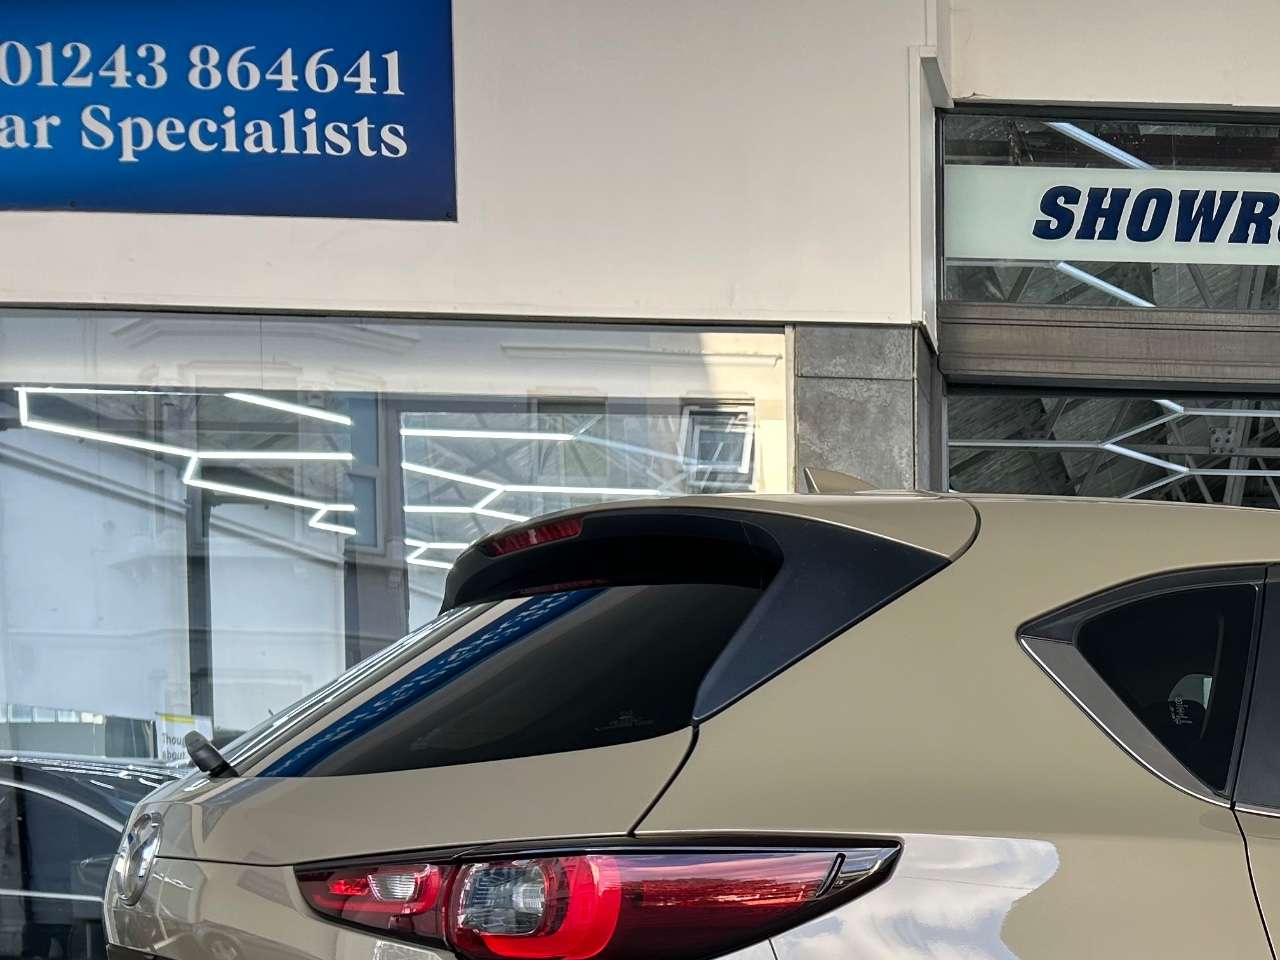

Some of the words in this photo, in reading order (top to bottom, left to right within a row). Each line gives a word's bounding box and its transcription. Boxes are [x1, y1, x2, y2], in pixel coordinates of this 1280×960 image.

[0, 40, 168, 89] 01243
[188, 45, 405, 95] 864641
[81, 104, 408, 162] Specialists
